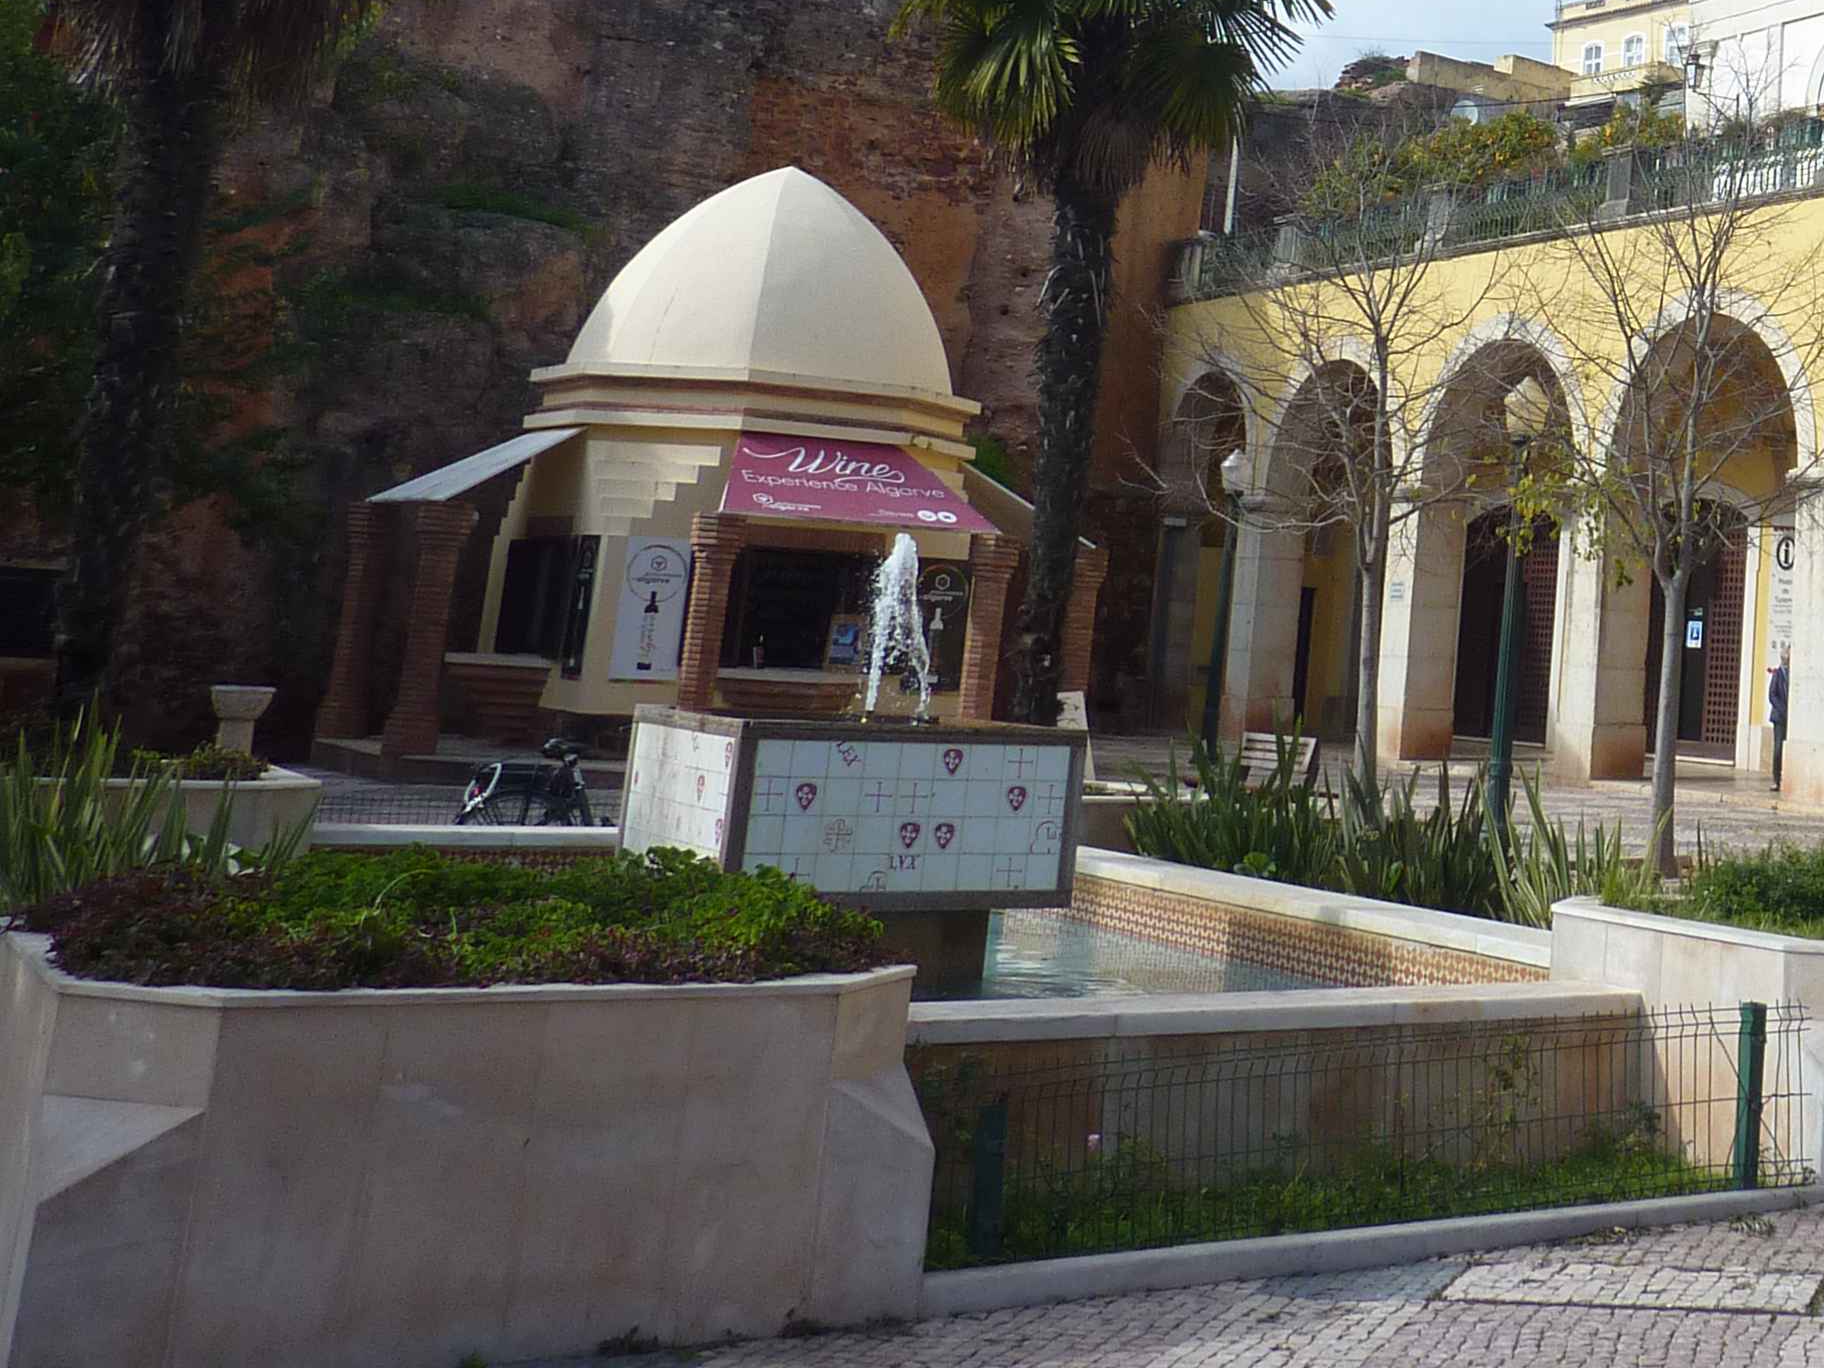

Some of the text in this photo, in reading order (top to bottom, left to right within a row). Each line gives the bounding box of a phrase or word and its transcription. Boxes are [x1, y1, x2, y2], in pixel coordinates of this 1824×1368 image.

[743, 446, 905, 483] Wine
[741, 469, 945, 498] Experience Algarve
